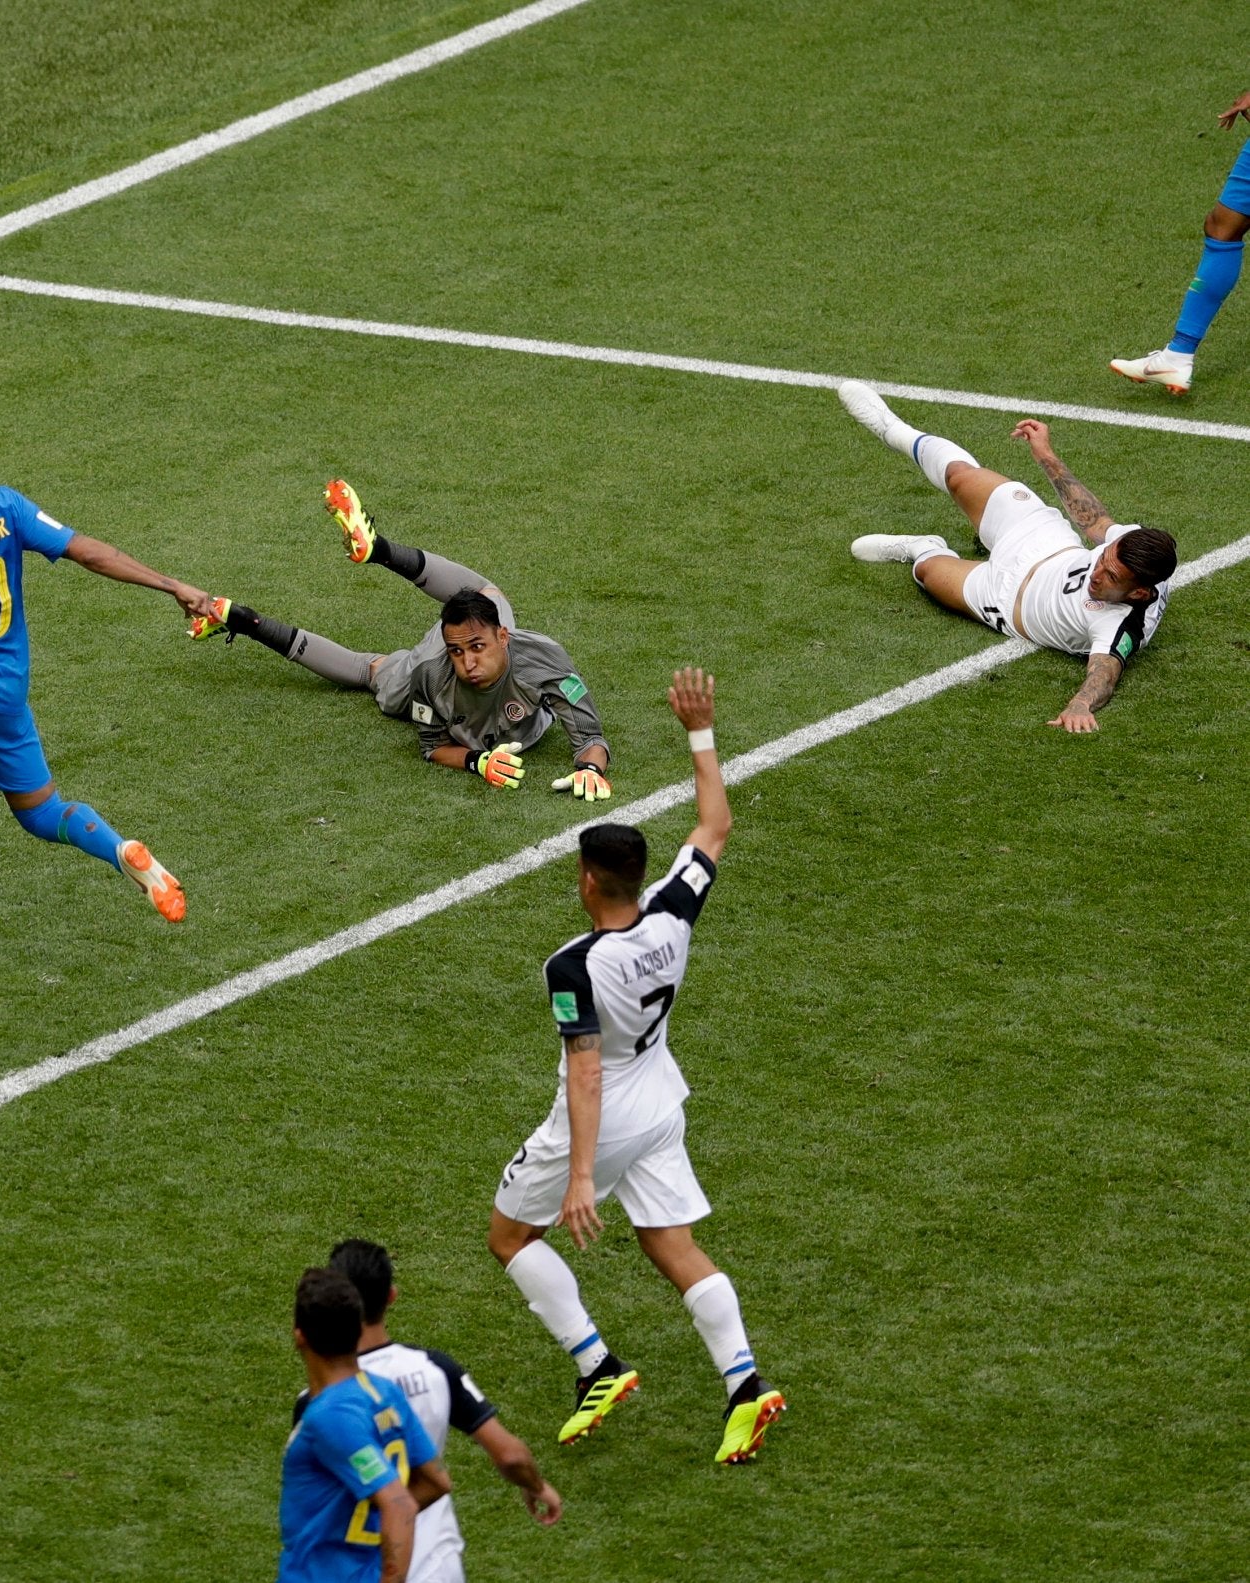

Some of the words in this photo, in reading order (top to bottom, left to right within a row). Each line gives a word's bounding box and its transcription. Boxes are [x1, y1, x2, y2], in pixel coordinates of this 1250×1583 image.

[619, 963, 633, 985] J.
[633, 941, 676, 980] ACOSTA
[634, 984, 675, 1057] 2
